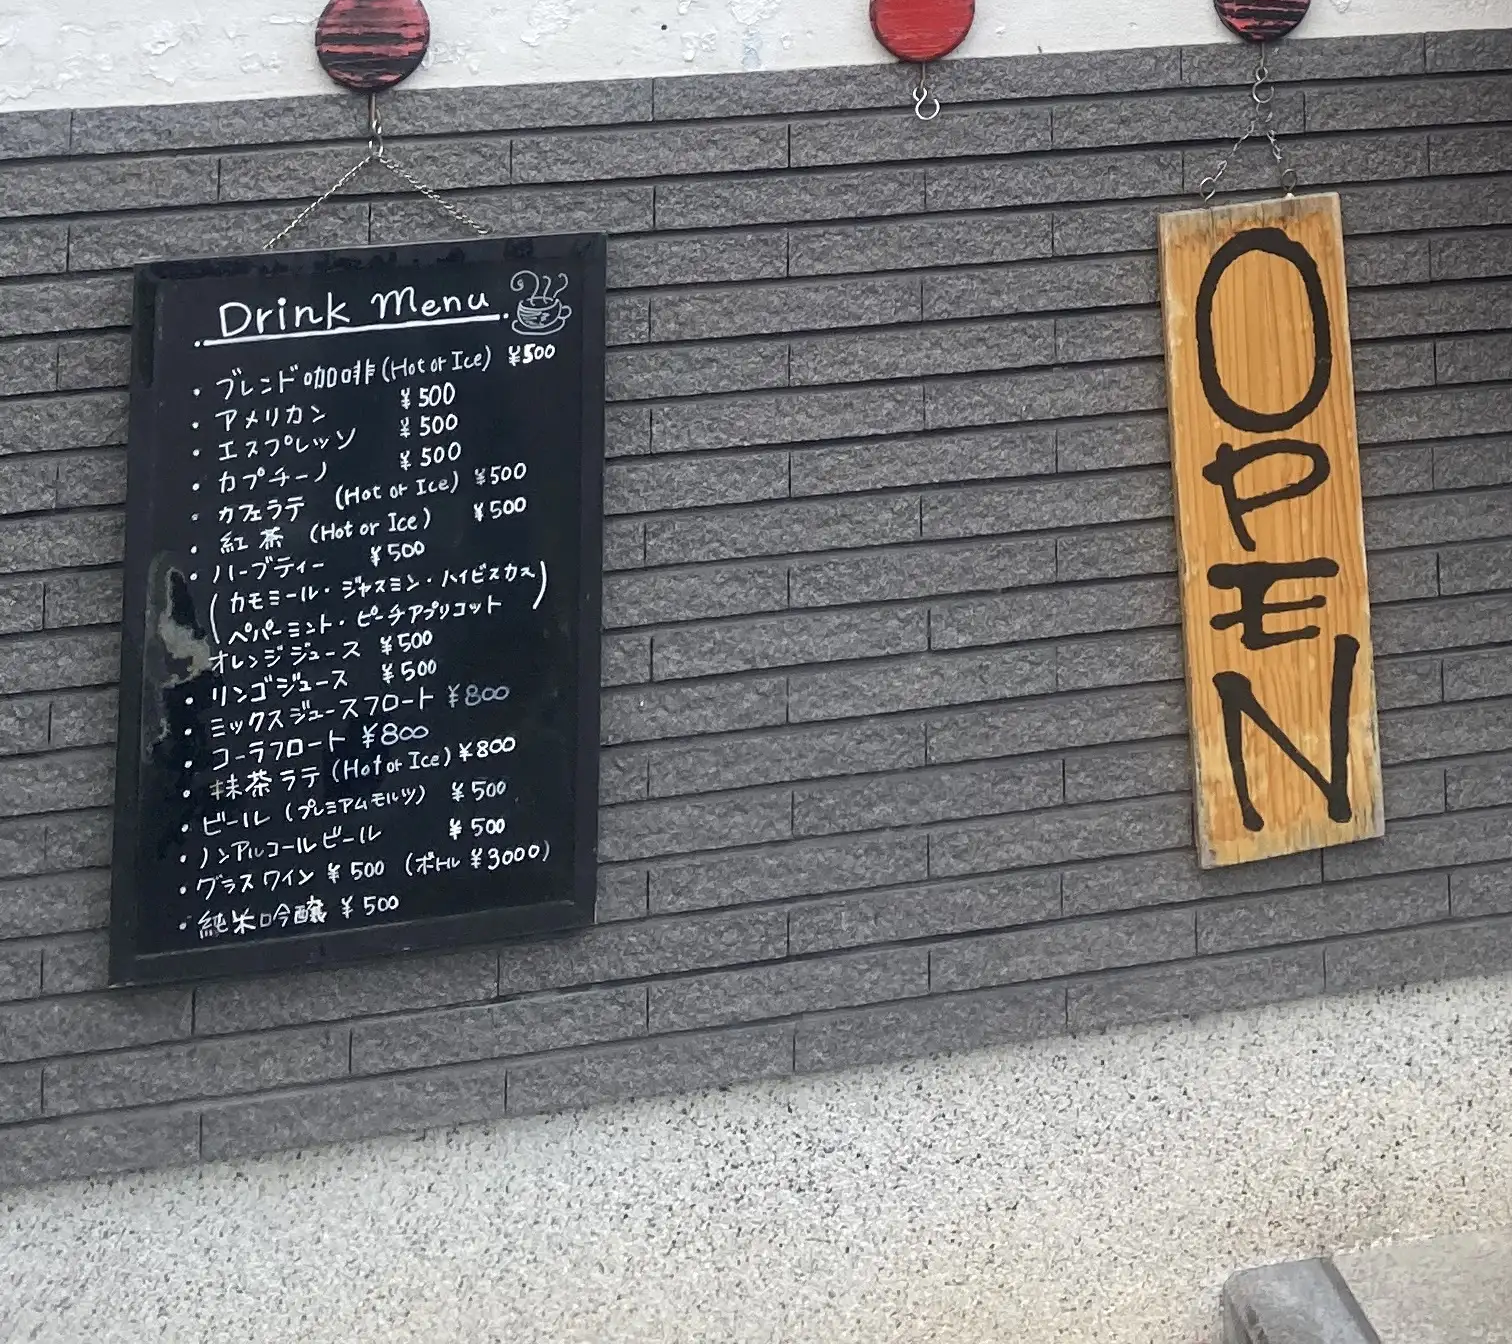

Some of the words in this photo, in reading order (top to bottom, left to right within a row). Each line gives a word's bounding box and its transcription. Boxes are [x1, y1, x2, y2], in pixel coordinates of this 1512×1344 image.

[219, 291, 350, 338] Drink
[370, 286, 490, 320] Menu
[430, 356, 447, 373] or
[215, 404, 327, 432] アメリカン
[218, 427, 357, 462] エスプレッソ
[218, 461, 328, 494] カプチーノ
[218, 495, 305, 525] カフェラテ
[389, 483, 408, 499] or
[220, 525, 284, 555] 紅茶
[359, 522, 380, 537] or
[1195, 226, 1361, 833] OPEN
[212, 555, 325, 584] ハーブティー
[212, 670, 348, 707] リンゴジュース
[212, 729, 345, 771] コーラフロート
[203, 810, 271, 836] ビール
[197, 894, 328, 940] 純米吟醸
